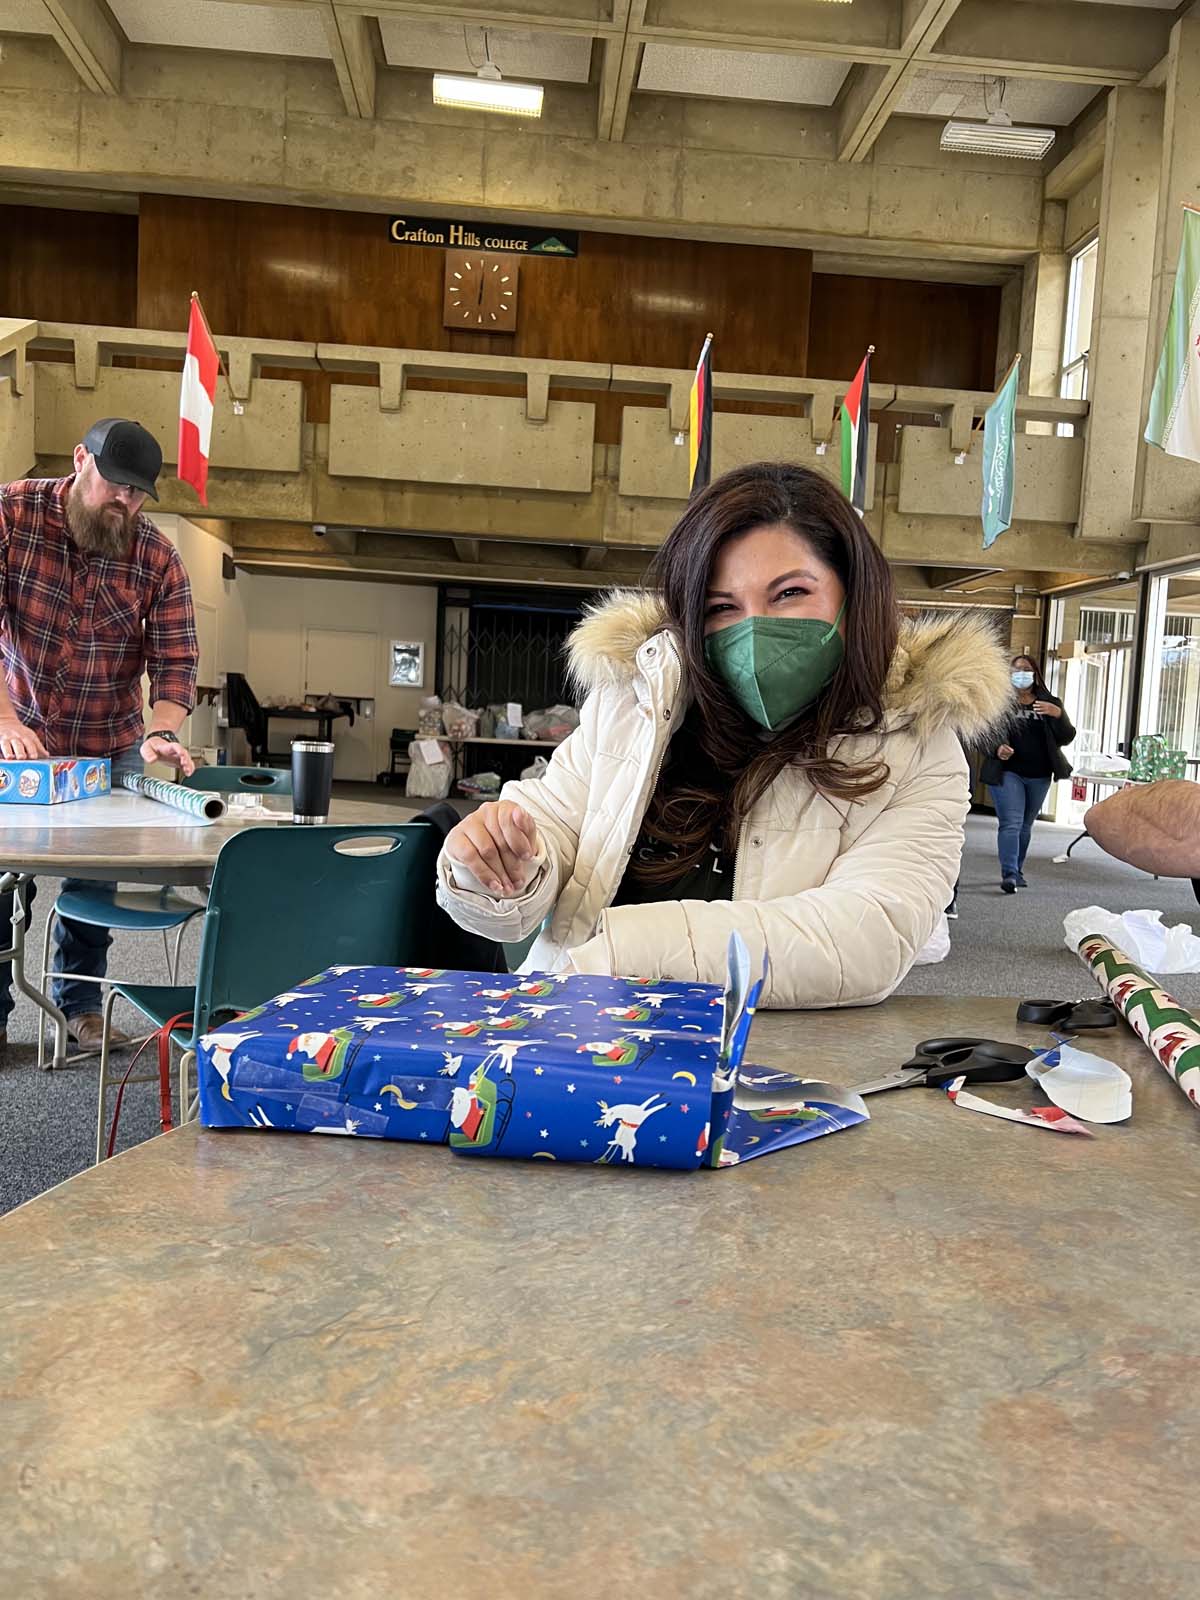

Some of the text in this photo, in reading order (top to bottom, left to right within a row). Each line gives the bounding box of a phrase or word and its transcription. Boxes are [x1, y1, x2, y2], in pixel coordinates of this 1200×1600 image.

[391, 219, 529, 251] Crafton Hills COLLEGE
